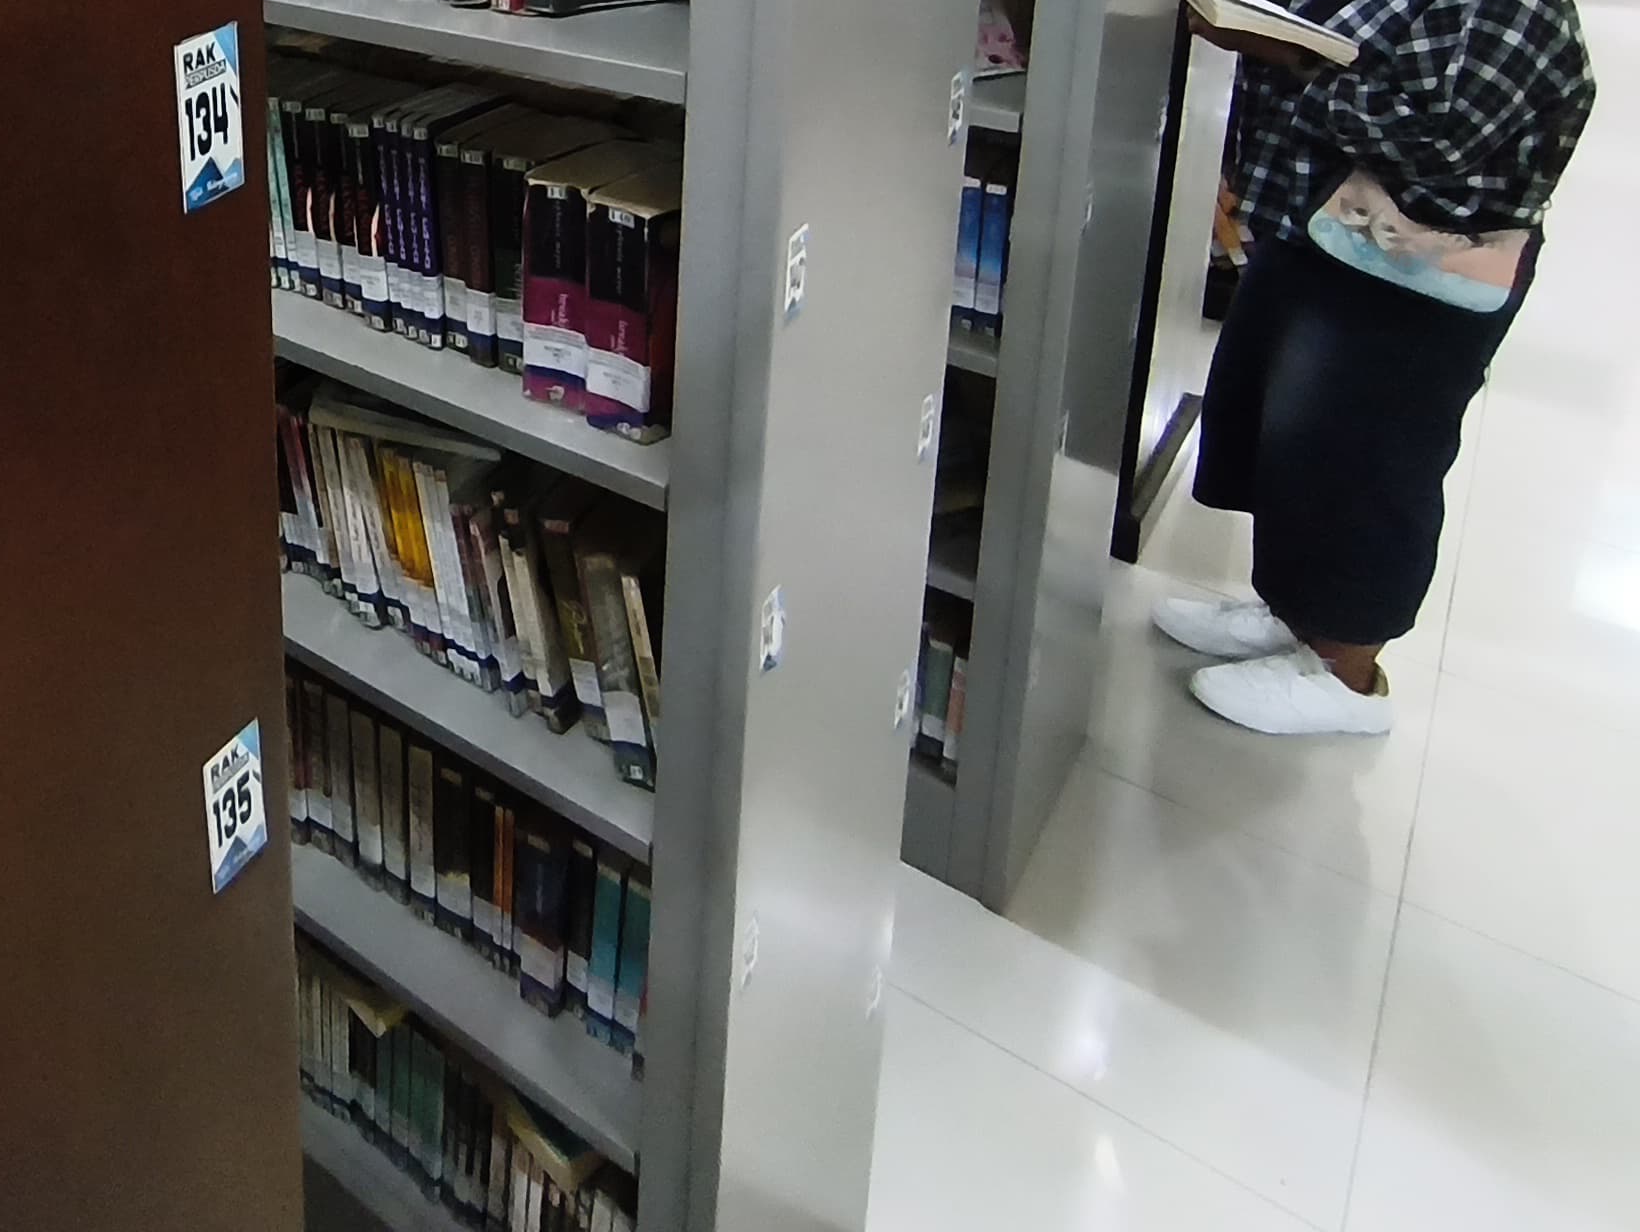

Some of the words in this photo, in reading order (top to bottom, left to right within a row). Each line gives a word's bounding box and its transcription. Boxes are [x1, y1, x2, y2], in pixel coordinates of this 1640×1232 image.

[183, 41, 216, 74] RAK
[185, 83, 228, 161] 134
[211, 745, 239, 779] RAK
[213, 770, 251, 848] 135
